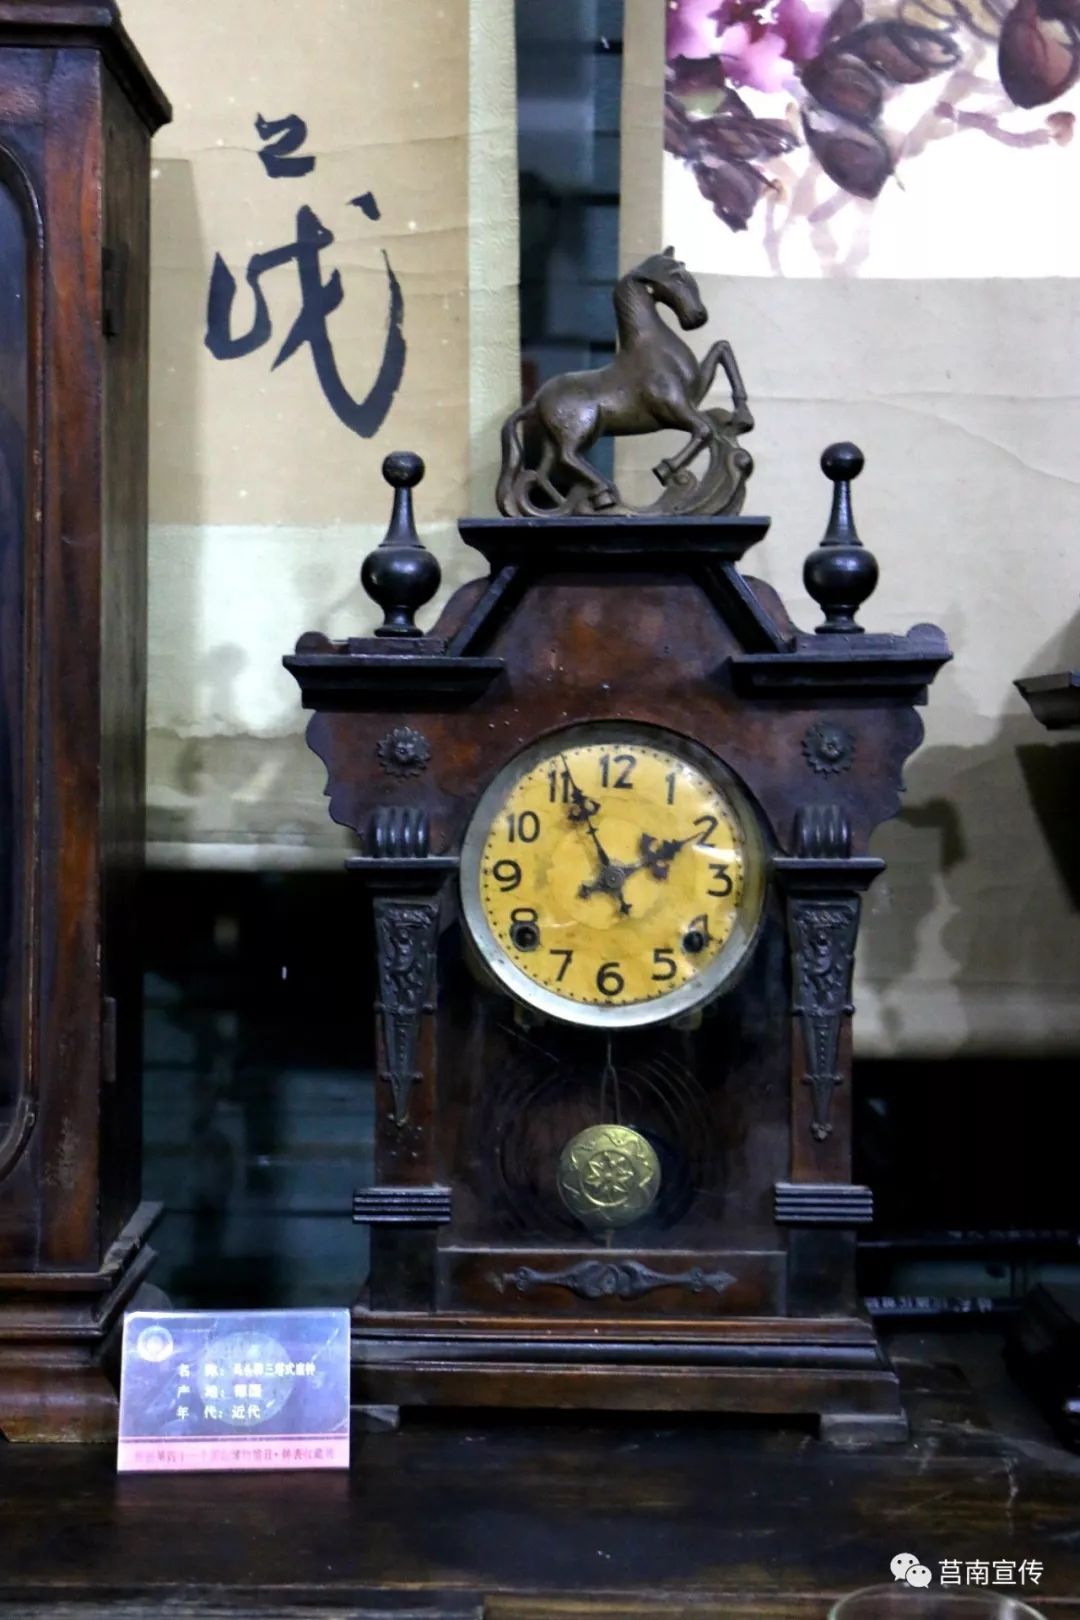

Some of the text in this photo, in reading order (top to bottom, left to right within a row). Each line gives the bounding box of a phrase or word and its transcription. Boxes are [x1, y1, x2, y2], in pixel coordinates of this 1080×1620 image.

[548, 770, 571, 804] 11
[600, 755, 637, 789] 12
[665, 773, 676, 805] 1
[505, 811, 540, 843] 10
[693, 815, 718, 847] 2
[492, 860, 522, 892] 9
[707, 864, 733, 897] 3
[550, 950, 573, 981] 7
[597, 963, 624, 996] 6
[651, 949, 677, 980] 5
